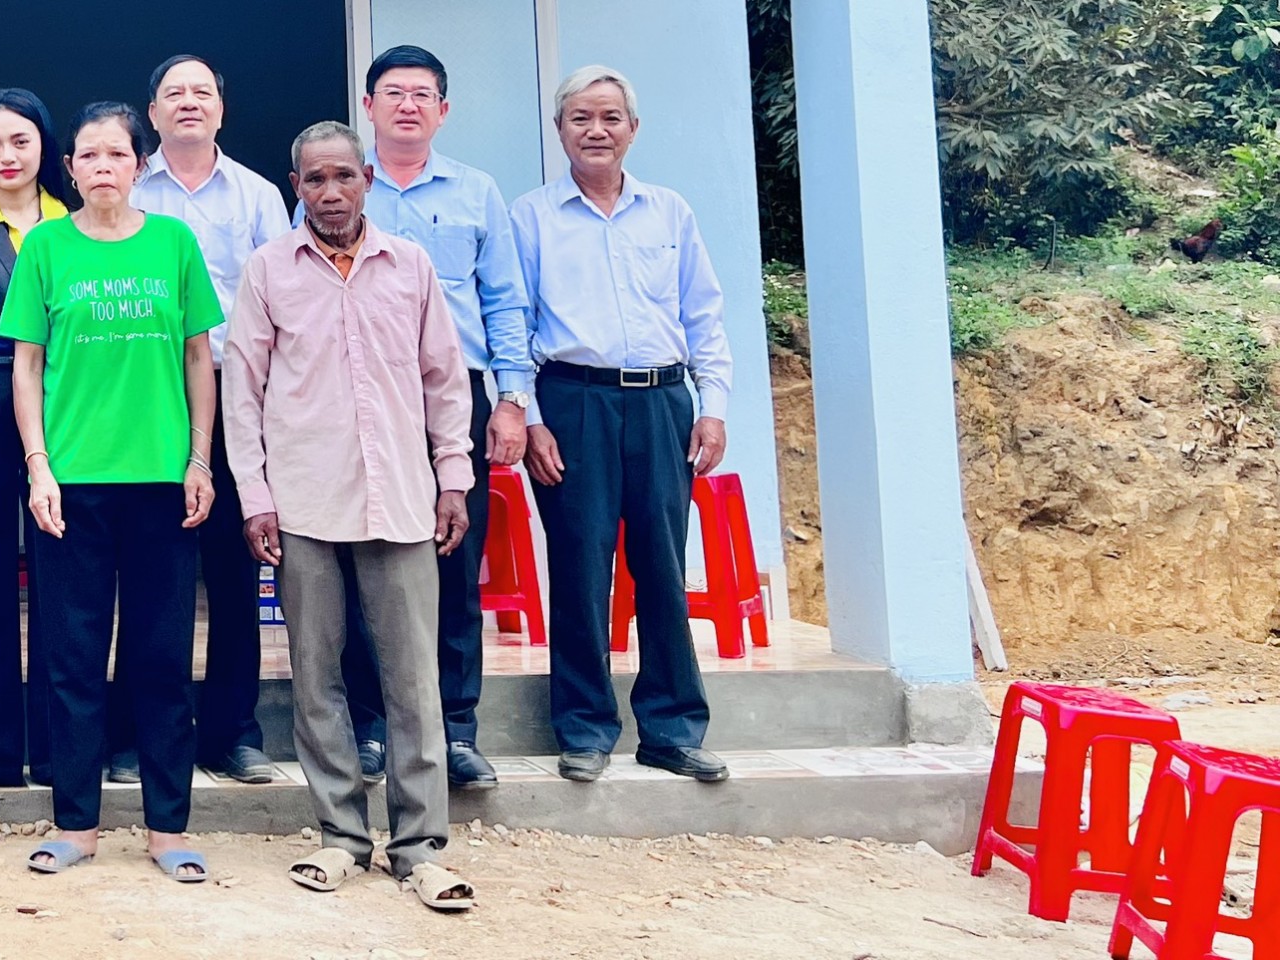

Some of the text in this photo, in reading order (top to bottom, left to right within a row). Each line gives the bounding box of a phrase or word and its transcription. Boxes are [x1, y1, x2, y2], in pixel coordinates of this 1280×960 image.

[69, 277, 169, 302] SOME MOMS CUSS
[89, 298, 156, 321] TOO MUCH.
